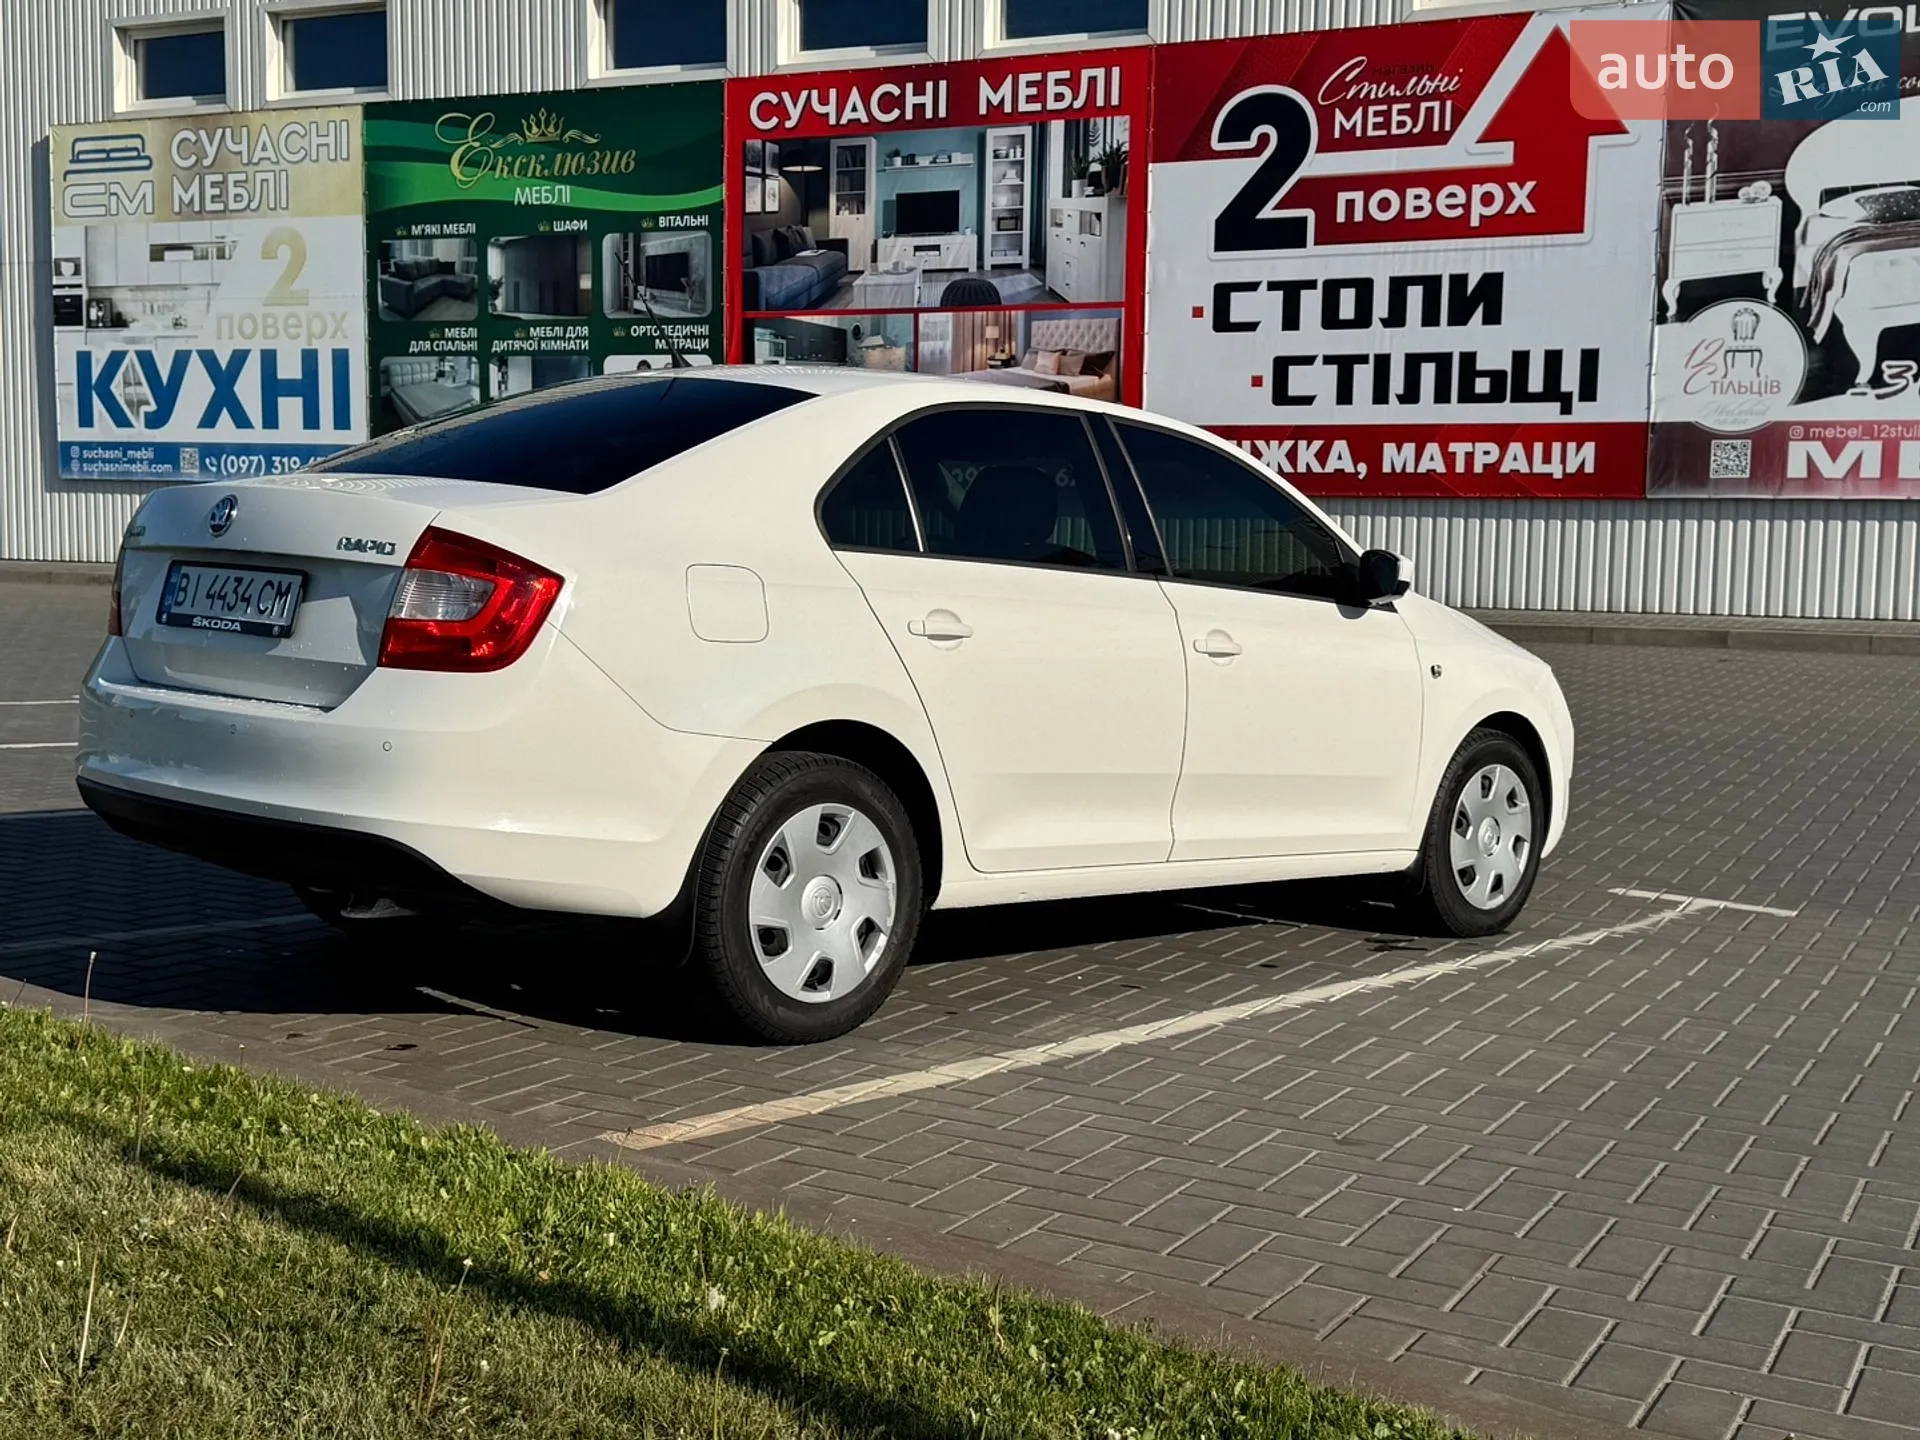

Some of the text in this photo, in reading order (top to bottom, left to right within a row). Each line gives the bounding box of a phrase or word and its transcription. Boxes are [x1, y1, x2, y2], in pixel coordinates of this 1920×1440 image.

[749, 66, 1121, 131] СУЧАСНІ МЕБЛІ
[1318, 56, 1463, 105] Стильні
[1334, 100, 1452, 138] МЕБЛІ
[170, 120, 350, 169] СУЧАСНІ
[435, 112, 636, 189] Ексклюзив
[1214, 91, 1313, 252] 2
[172, 169, 289, 214] МЕБЛІ
[514, 185, 571, 206] МЕБЛІ
[1336, 179, 1538, 228] поверх
[443, 223, 476, 235] МЕБЛІ
[553, 219, 588, 232] ШАФИ
[658, 214, 709, 228] ВІТАЛЬНІ
[261, 226, 310, 306] 2
[1212, 271, 1504, 333] СТОЛИ
[216, 311, 349, 346] поверх
[408, 340, 478, 353] ДЛЯ СПАЛЬНІ
[444, 328, 478, 339] МЕБЛІ
[491, 338, 589, 352] ДИТЯЧОЇ КІМНАТИ
[529, 326, 589, 339] МЕБЛІ ДЛЯ
[655, 338, 709, 352] МТРАЦИ
[76, 348, 351, 430] КУХНІ
[1271, 348, 1600, 415] СТІЛЬЦІ
[83, 446, 154, 460] suchasni_mebli
[83, 460, 173, 473] suchasnimebli.com
[221, 453, 266, 476] (097)
[1228, 440, 1595, 480] ЖКА, МАТРАЦИ
[174, 572, 292, 619] BI 4434 CM
